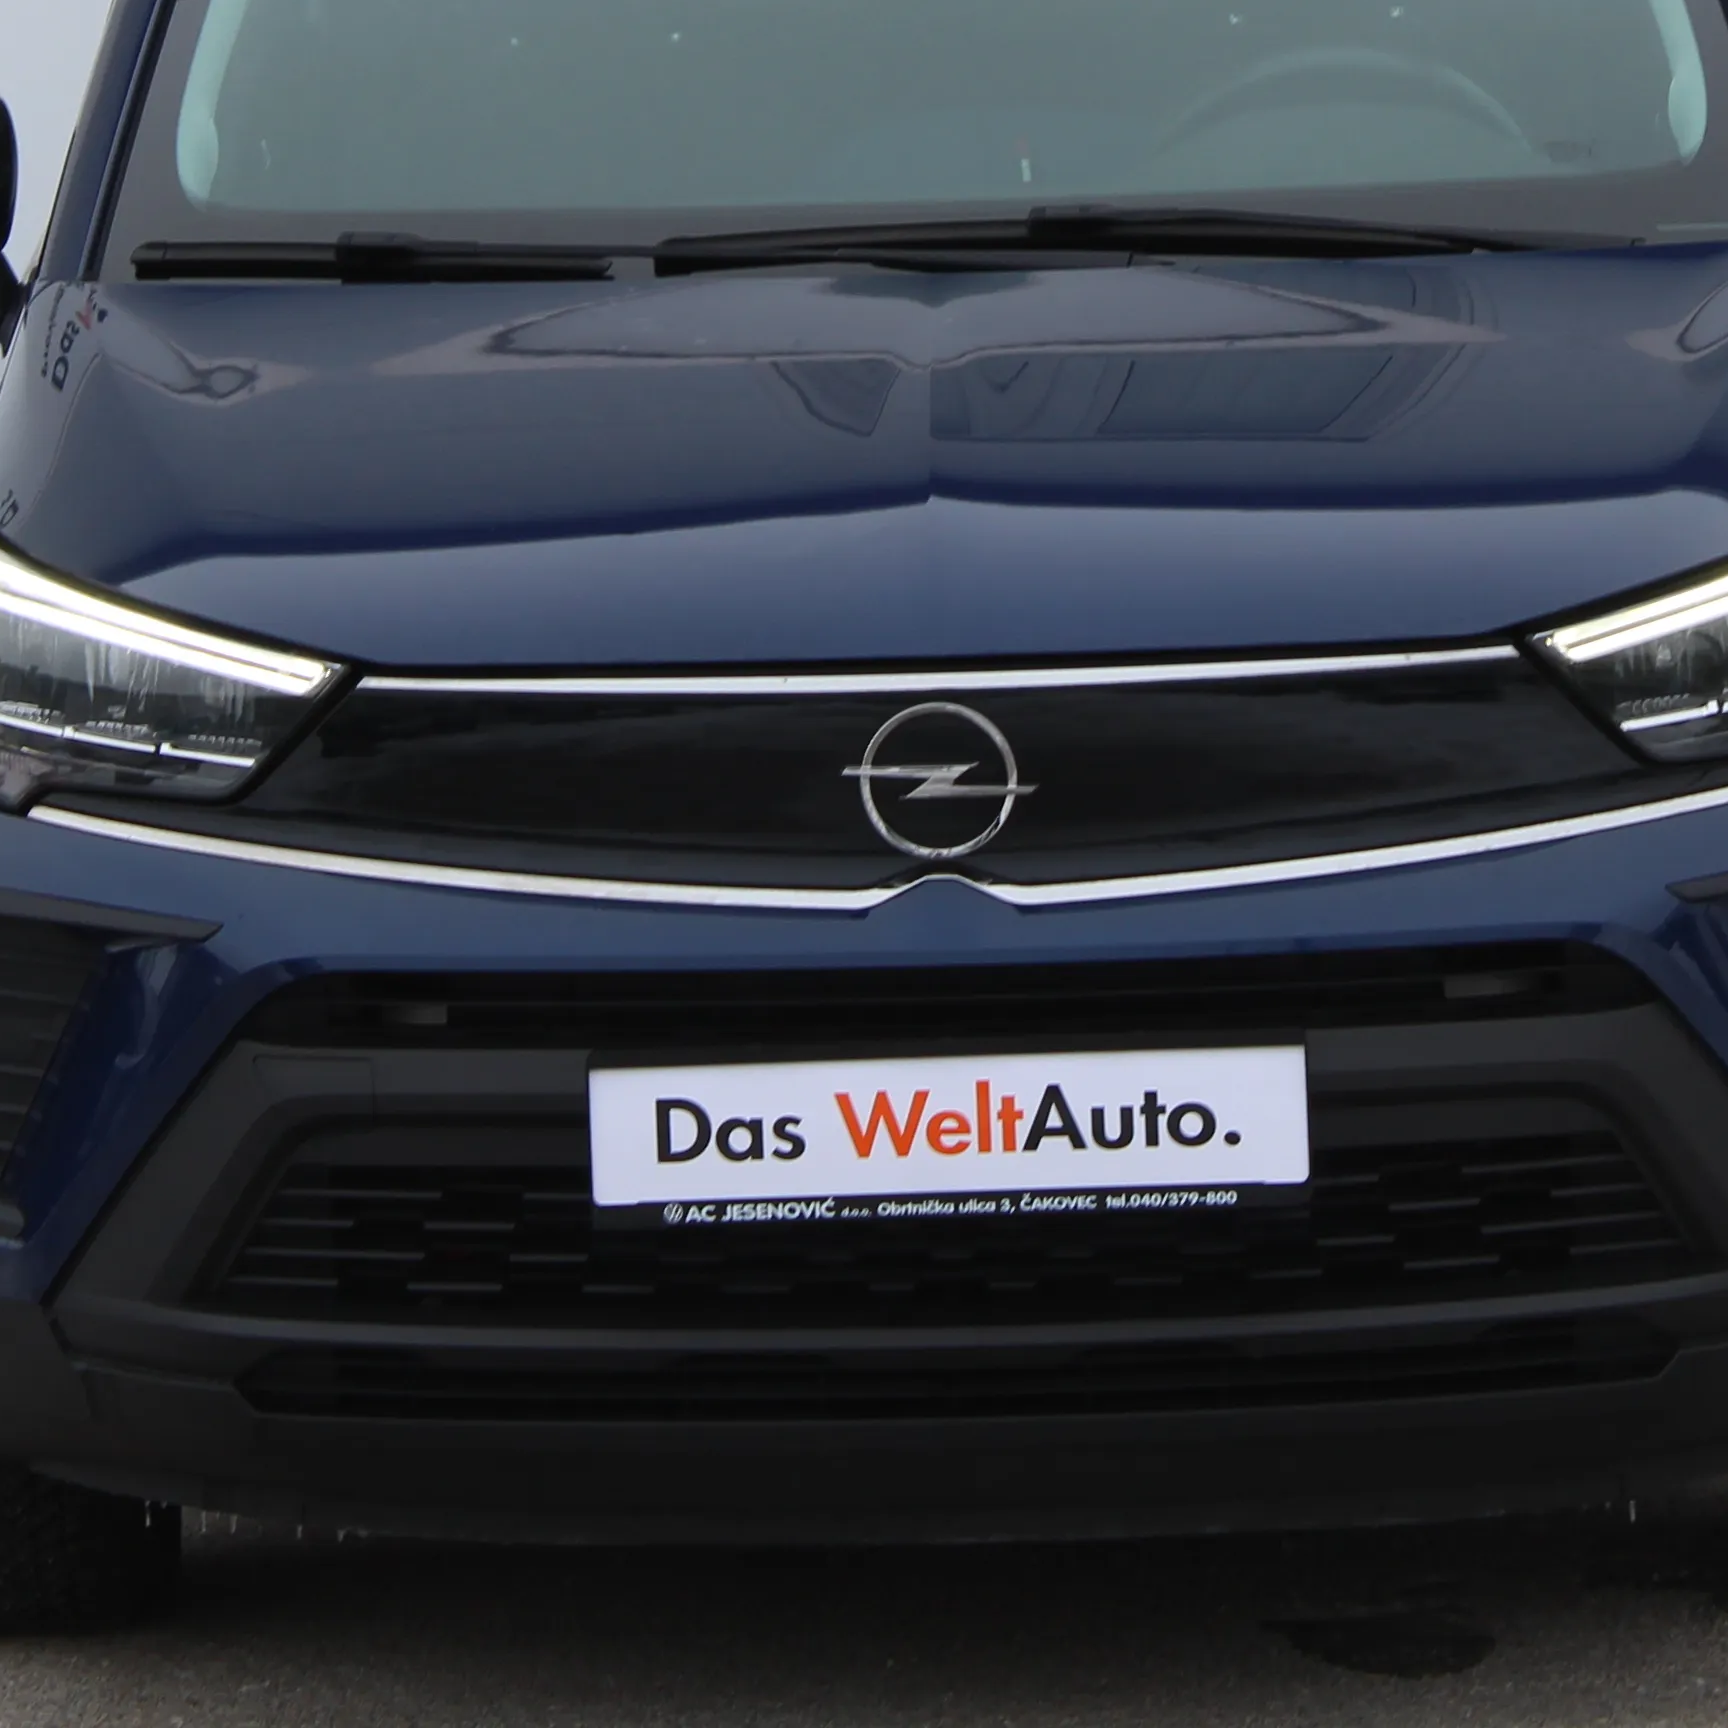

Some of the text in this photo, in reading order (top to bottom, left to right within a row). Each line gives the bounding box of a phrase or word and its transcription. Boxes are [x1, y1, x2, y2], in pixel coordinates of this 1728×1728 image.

[655, 1080, 1242, 1164] Das WeltAuto.
[685, 1204, 717, 1223] AC
[721, 1196, 836, 1222] JESENOVIĆ
[958, 1198, 996, 1214] ulica
[1020, 1193, 1098, 1212] ČAKOVEC
